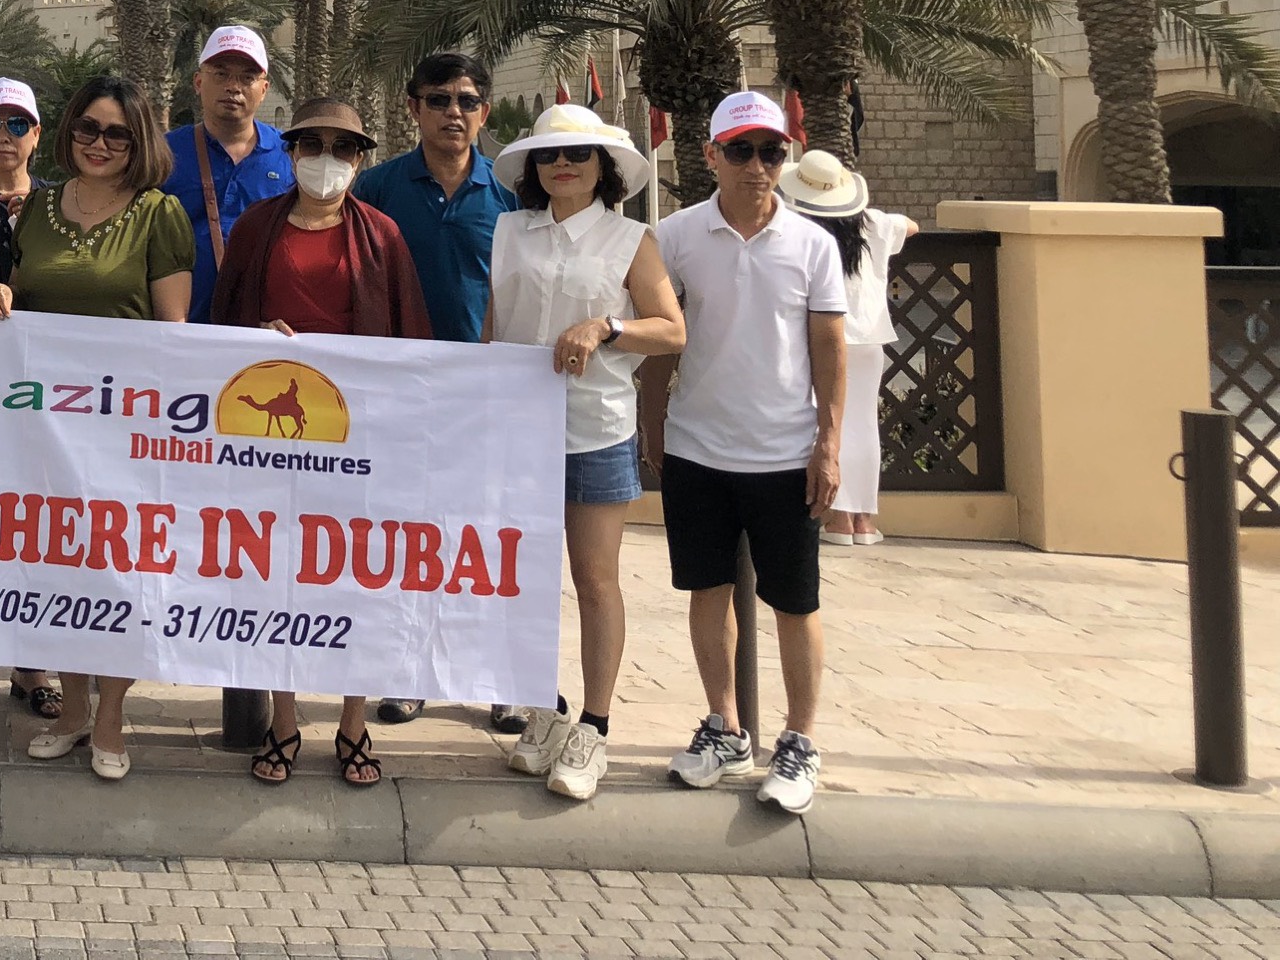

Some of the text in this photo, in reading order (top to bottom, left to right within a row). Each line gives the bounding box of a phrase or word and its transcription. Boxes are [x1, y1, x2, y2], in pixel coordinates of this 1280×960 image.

[218, 34, 235, 44] GROUP
[729, 104, 753, 115] GROUP
[130, 432, 372, 476] Dubai Adventures
[197, 507, 277, 581] IN
[296, 514, 523, 597] DUBAI
[163, 604, 352, 650] 31/05/2022
